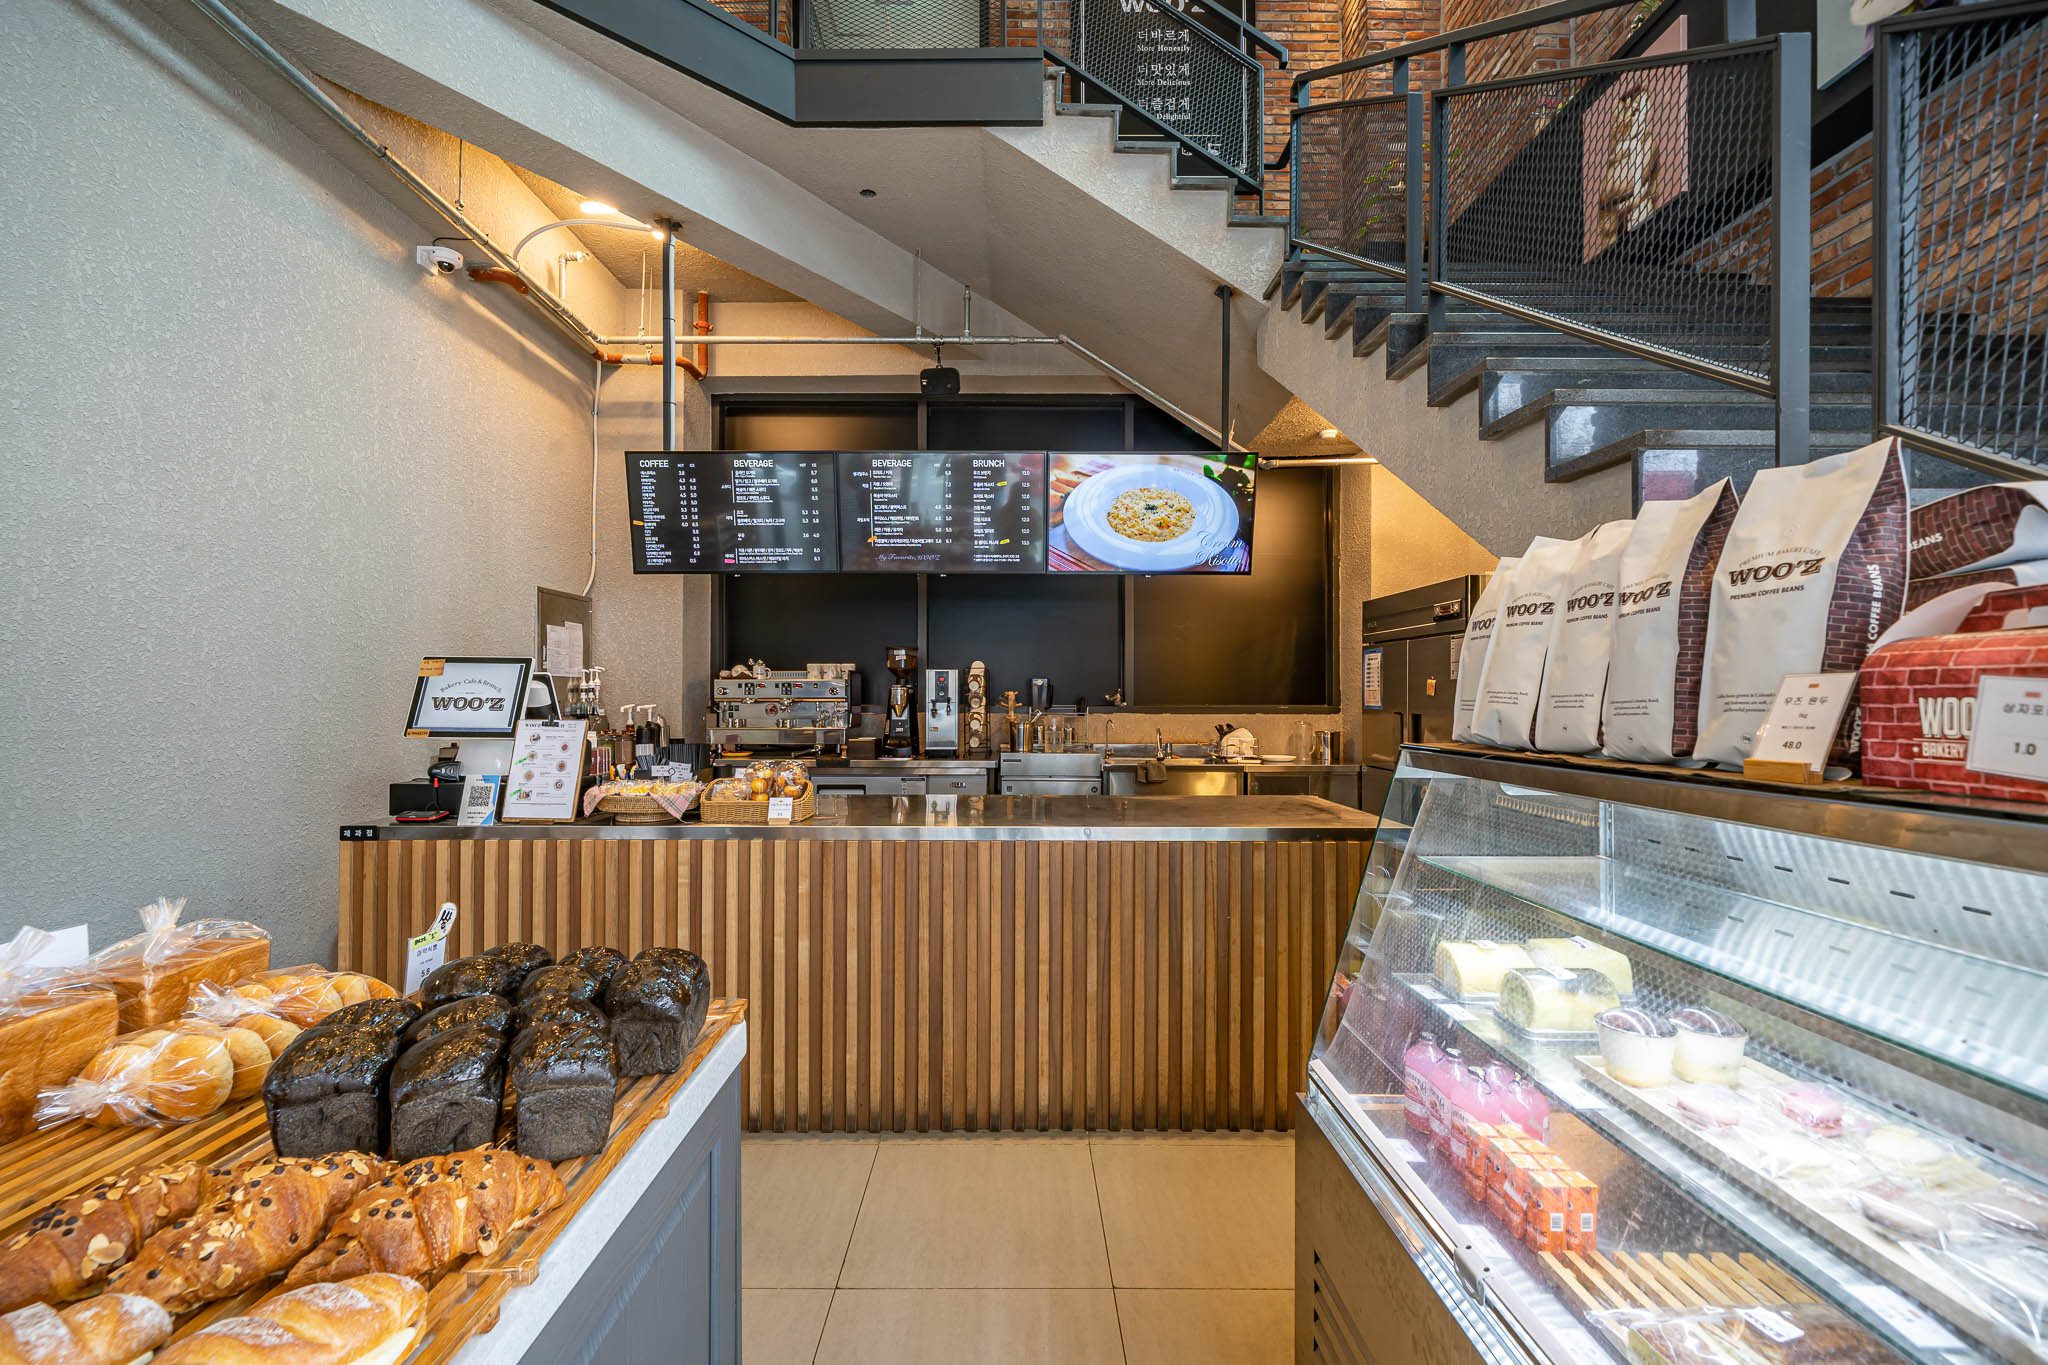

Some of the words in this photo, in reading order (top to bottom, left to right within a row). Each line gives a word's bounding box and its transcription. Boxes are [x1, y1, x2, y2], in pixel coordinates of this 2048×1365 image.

[640, 460, 669, 468] COFFEE
[734, 459, 774, 468] BEVERAGE
[872, 459, 912, 467] BEVERAGE
[973, 459, 1005, 467] BRUNCH
[1197, 531, 1244, 549] Cream
[1195, 551, 1244, 567] Risotto
[1729, 556, 1826, 587] WOO'Z
[1866, 564, 1883, 598] BEANS
[1618, 581, 1672, 607] WOO'Z
[1730, 591, 1757, 600] PREMIUM
[1758, 588, 1780, 597] COFFEE
[1781, 584, 1805, 593] BEANS
[1506, 602, 1556, 618] WOO'Z
[1567, 592, 1615, 613] WOO'Z
[1868, 600, 1881, 640] COFFEE
[482, 680, 503, 693] Brunch
[431, 696, 506, 712] WOO'Z
[1782, 741, 1802, 750] 48.0
[1922, 742, 1967, 759] BAKERY
[2014, 742, 2037, 756] 1.0
